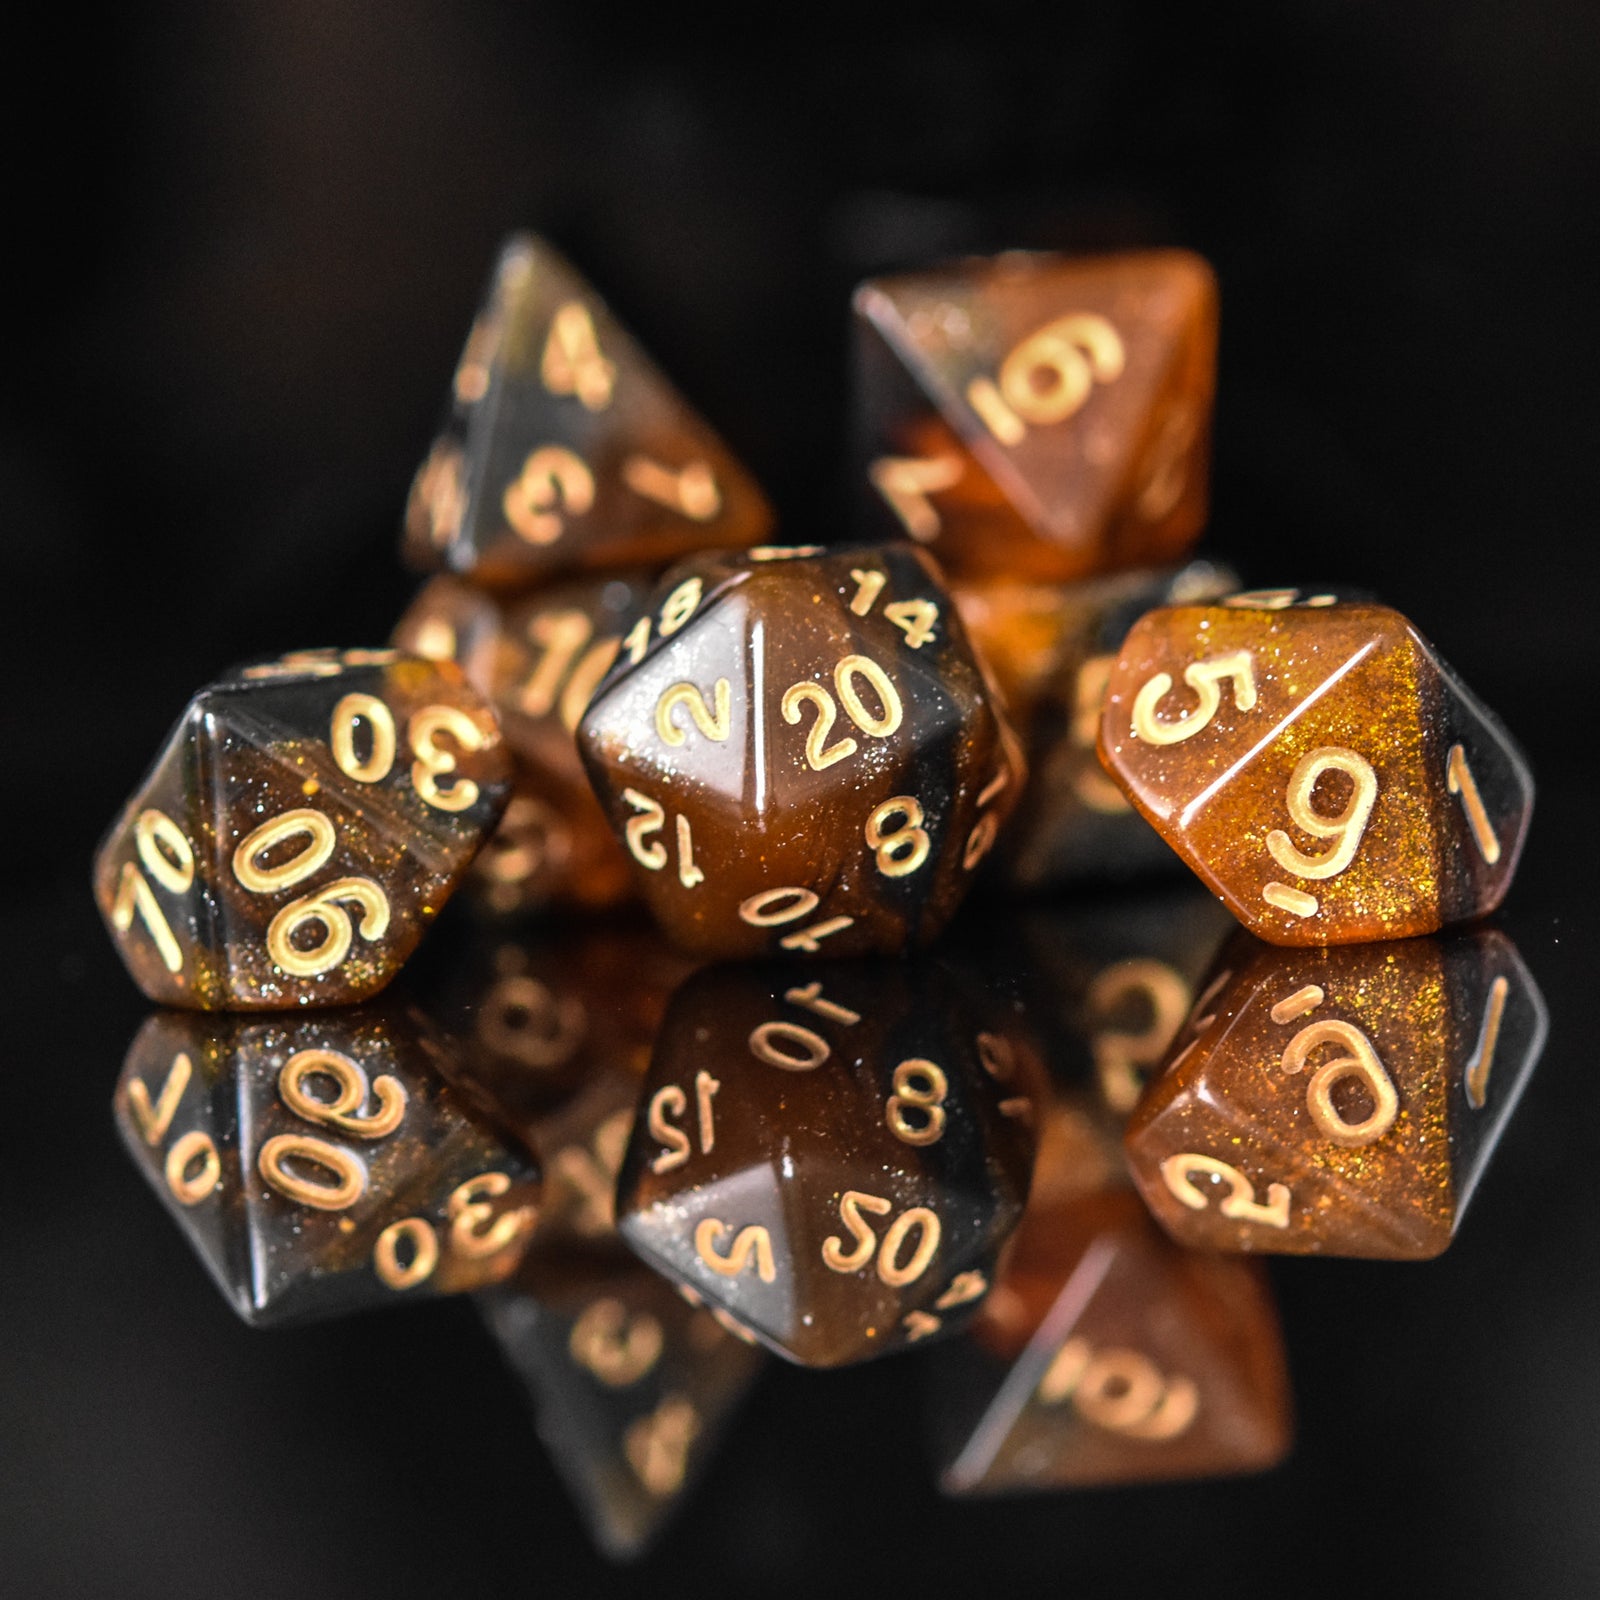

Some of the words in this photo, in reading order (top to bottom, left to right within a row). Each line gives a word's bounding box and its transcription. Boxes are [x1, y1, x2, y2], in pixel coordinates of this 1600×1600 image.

[968, 312, 1125, 448] 6
[624, 577, 703, 665] 18
[850, 569, 938, 648] 14
[654, 677, 731, 747] 2
[780, 654, 904, 771] 20
[1131, 650, 1257, 745] 5
[330, 692, 482, 812] 30
[624, 787, 704, 888] 12
[865, 795, 931, 878] 8
[1262, 746, 1380, 918] 9
[1447, 744, 1501, 864] 1
[738, 886, 854, 952] 10
